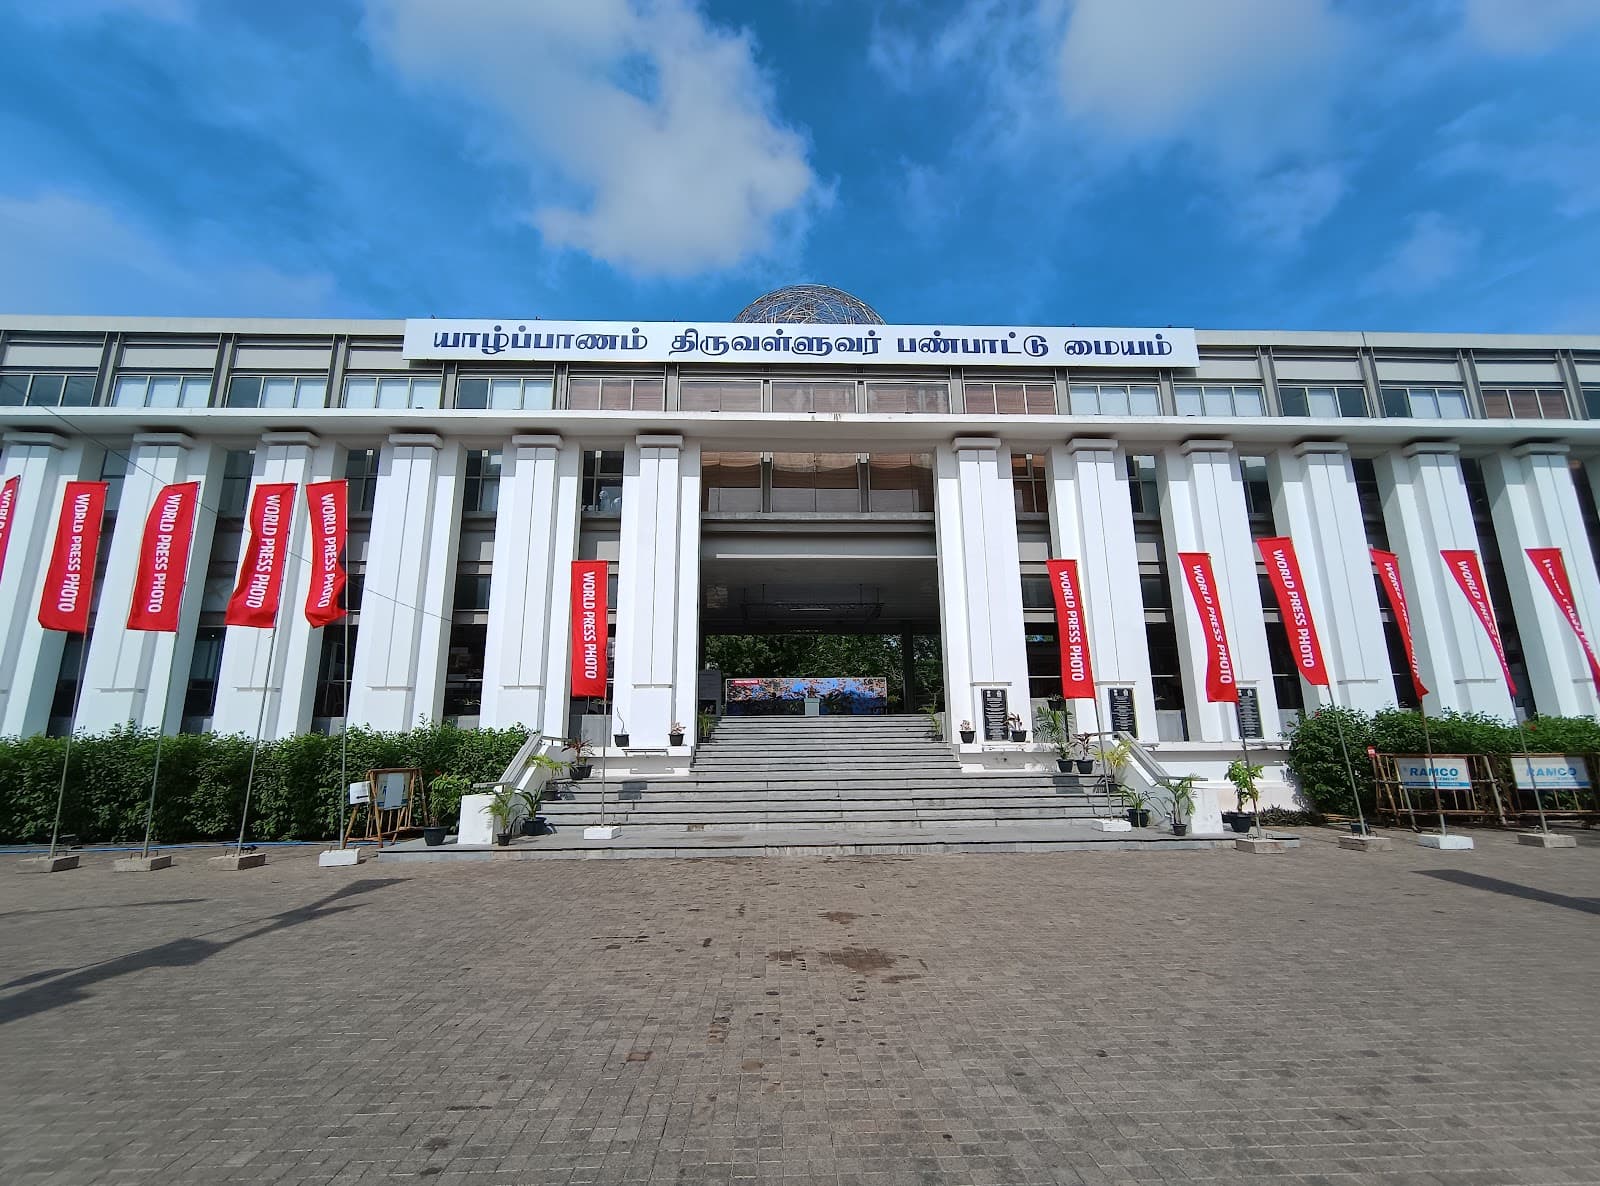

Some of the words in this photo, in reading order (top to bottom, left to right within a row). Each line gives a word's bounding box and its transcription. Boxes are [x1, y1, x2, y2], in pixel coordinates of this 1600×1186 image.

[433, 325, 648, 354] யாழ்ப்பாணம்
[669, 327, 882, 357] திருவள்ளுவர்
[897, 330, 1049, 357] பண்பாட்டு
[1064, 333, 1173, 356] மையம்
[72, 493, 91, 533] WORLD
[159, 493, 182, 532] WORLD
[262, 494, 280, 536] WORLD
[320, 493, 336, 535] WORLD
[67, 535, 83, 571] PRESS
[154, 534, 172, 571] PRESS
[255, 537, 275, 573] PRESS
[324, 536, 337, 571] PRESS
[57, 573, 80, 613] PHOTO
[147, 573, 167, 613] PHOTO
[245, 574, 271, 608] PHOTO
[317, 573, 336, 608] PHOTO
[582, 571, 596, 609] WORLD
[1058, 571, 1076, 609] WORLD
[1456, 560, 1481, 599] WORLD
[583, 611, 596, 642] PRESS
[1067, 610, 1081, 643] PRESS
[1192, 564, 1213, 605] WORLD
[1206, 605, 1224, 645] PRESS
[1217, 644, 1233, 684] PHOTO
[1273, 549, 1294, 589] WORLD
[1287, 591, 1307, 626] PRESS
[1297, 628, 1315, 668] PHOTO
[584, 644, 598, 679] PHOTO
[1070, 645, 1085, 682] PHOTO
[1409, 767, 1459, 777] RAMCO
